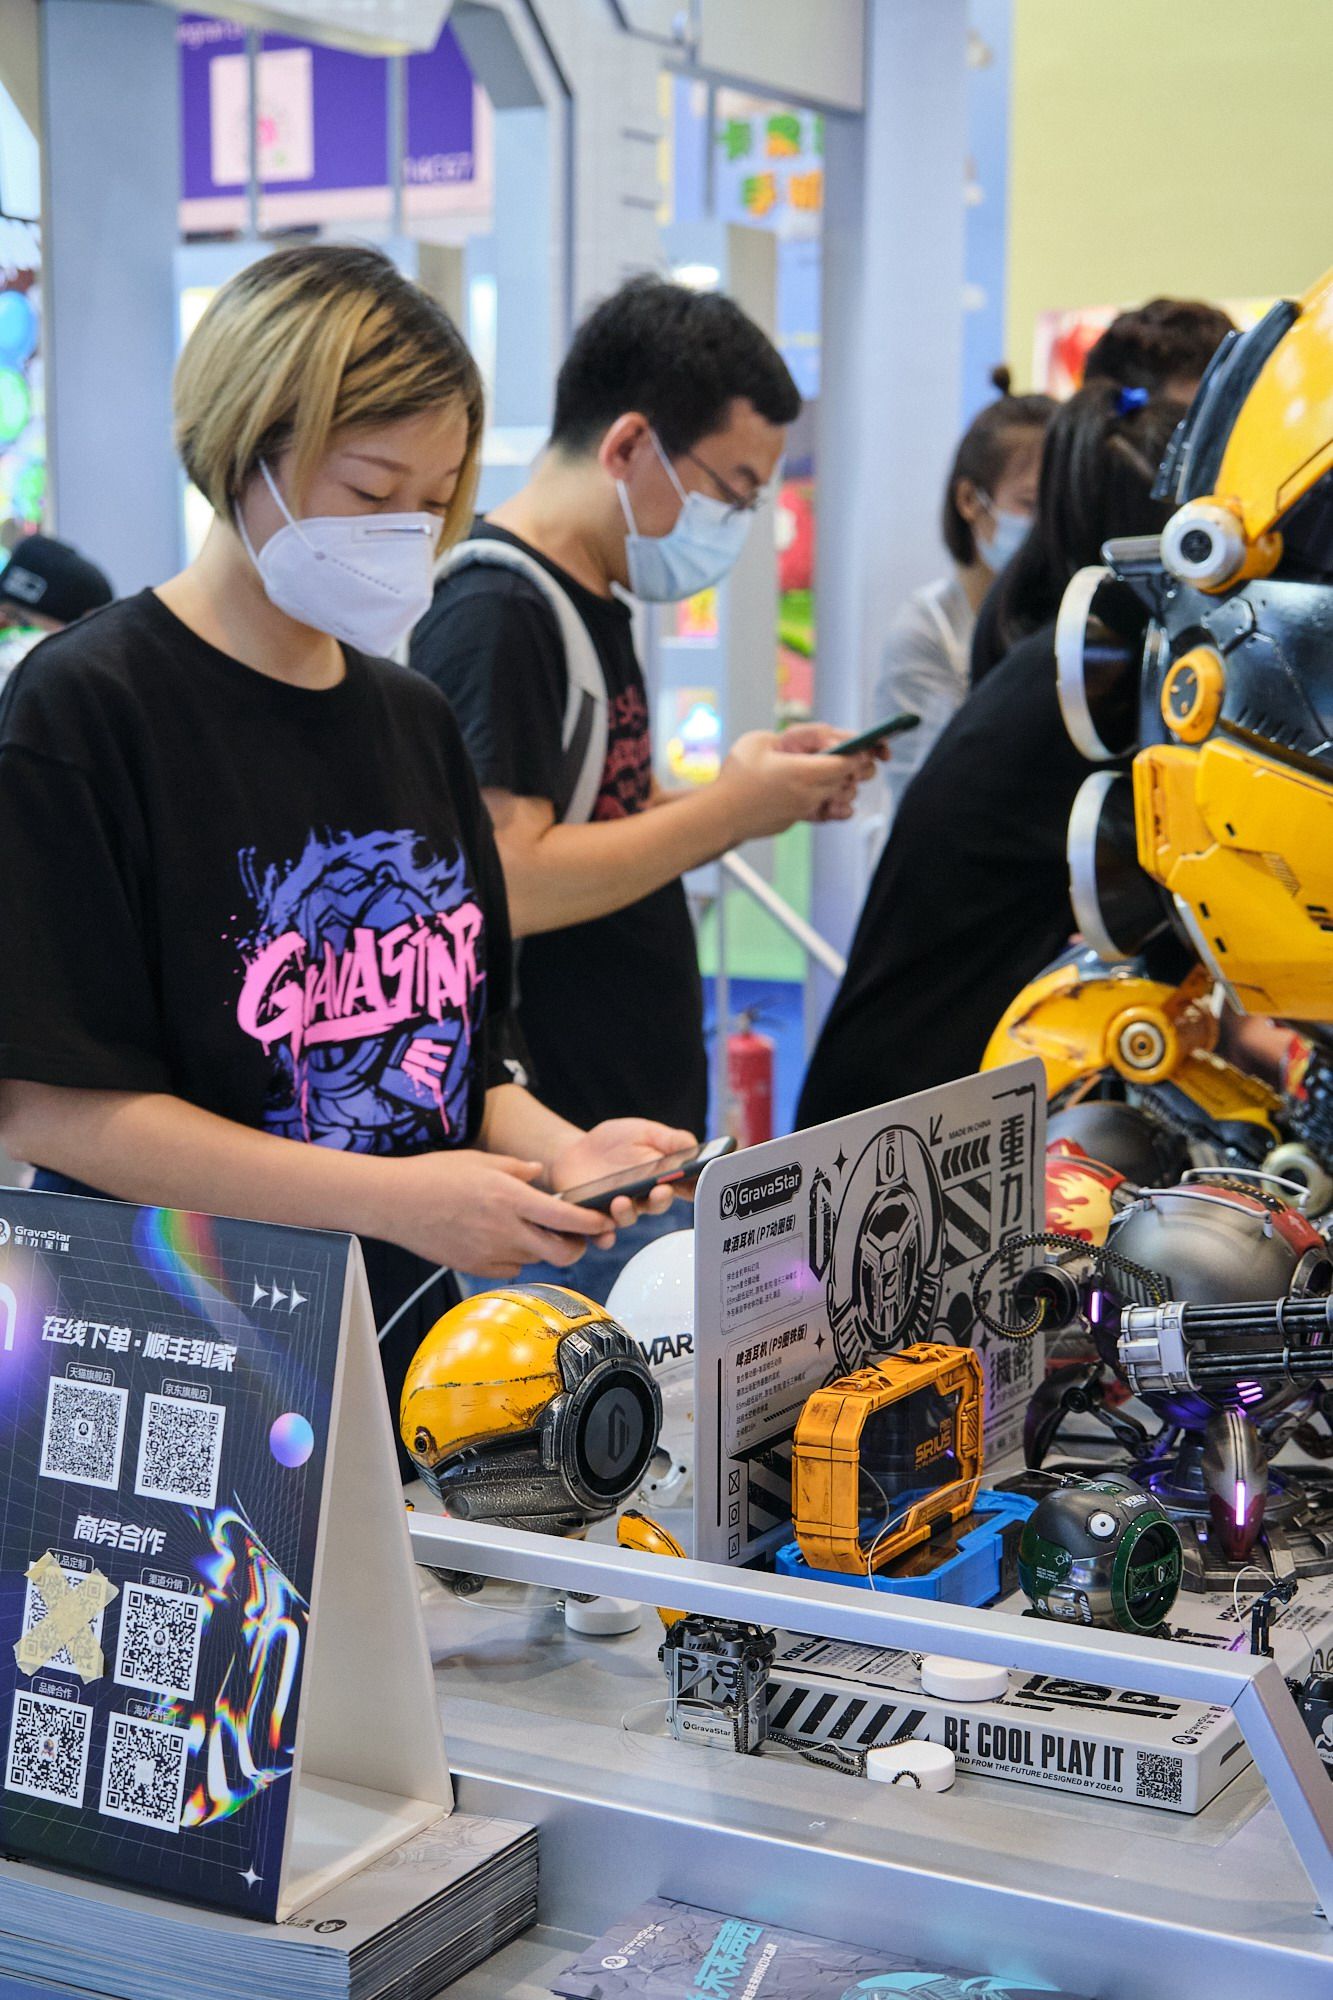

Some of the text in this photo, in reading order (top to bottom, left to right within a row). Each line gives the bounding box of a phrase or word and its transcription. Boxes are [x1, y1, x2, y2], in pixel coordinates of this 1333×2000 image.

[739, 1173, 800, 1205] GravaStar
[14, 1225, 71, 1242] GravaStar
[69, 1366, 112, 1384] 天猫旗舰店
[164, 1383, 209, 1401] 京东旗舰店
[73, 1514, 167, 1556] 商务合作
[149, 1574, 183, 1591] 渠道分销
[38, 1682, 72, 1699] 品牌合作
[134, 1705, 170, 1721] 海外合作
[691, 1724, 731, 1736] GravaStar
[944, 1715, 1124, 1783] BE COOL PLAY IT
[971, 1758, 994, 1769] FROM
[995, 1763, 1010, 1772] THE
[1011, 1766, 1042, 1778] FUTURE
[1042, 1772, 1083, 1786] DESIGNED
[1083, 1780, 1096, 1788] BY
[1095, 1782, 1124, 1793] ZOEAO
